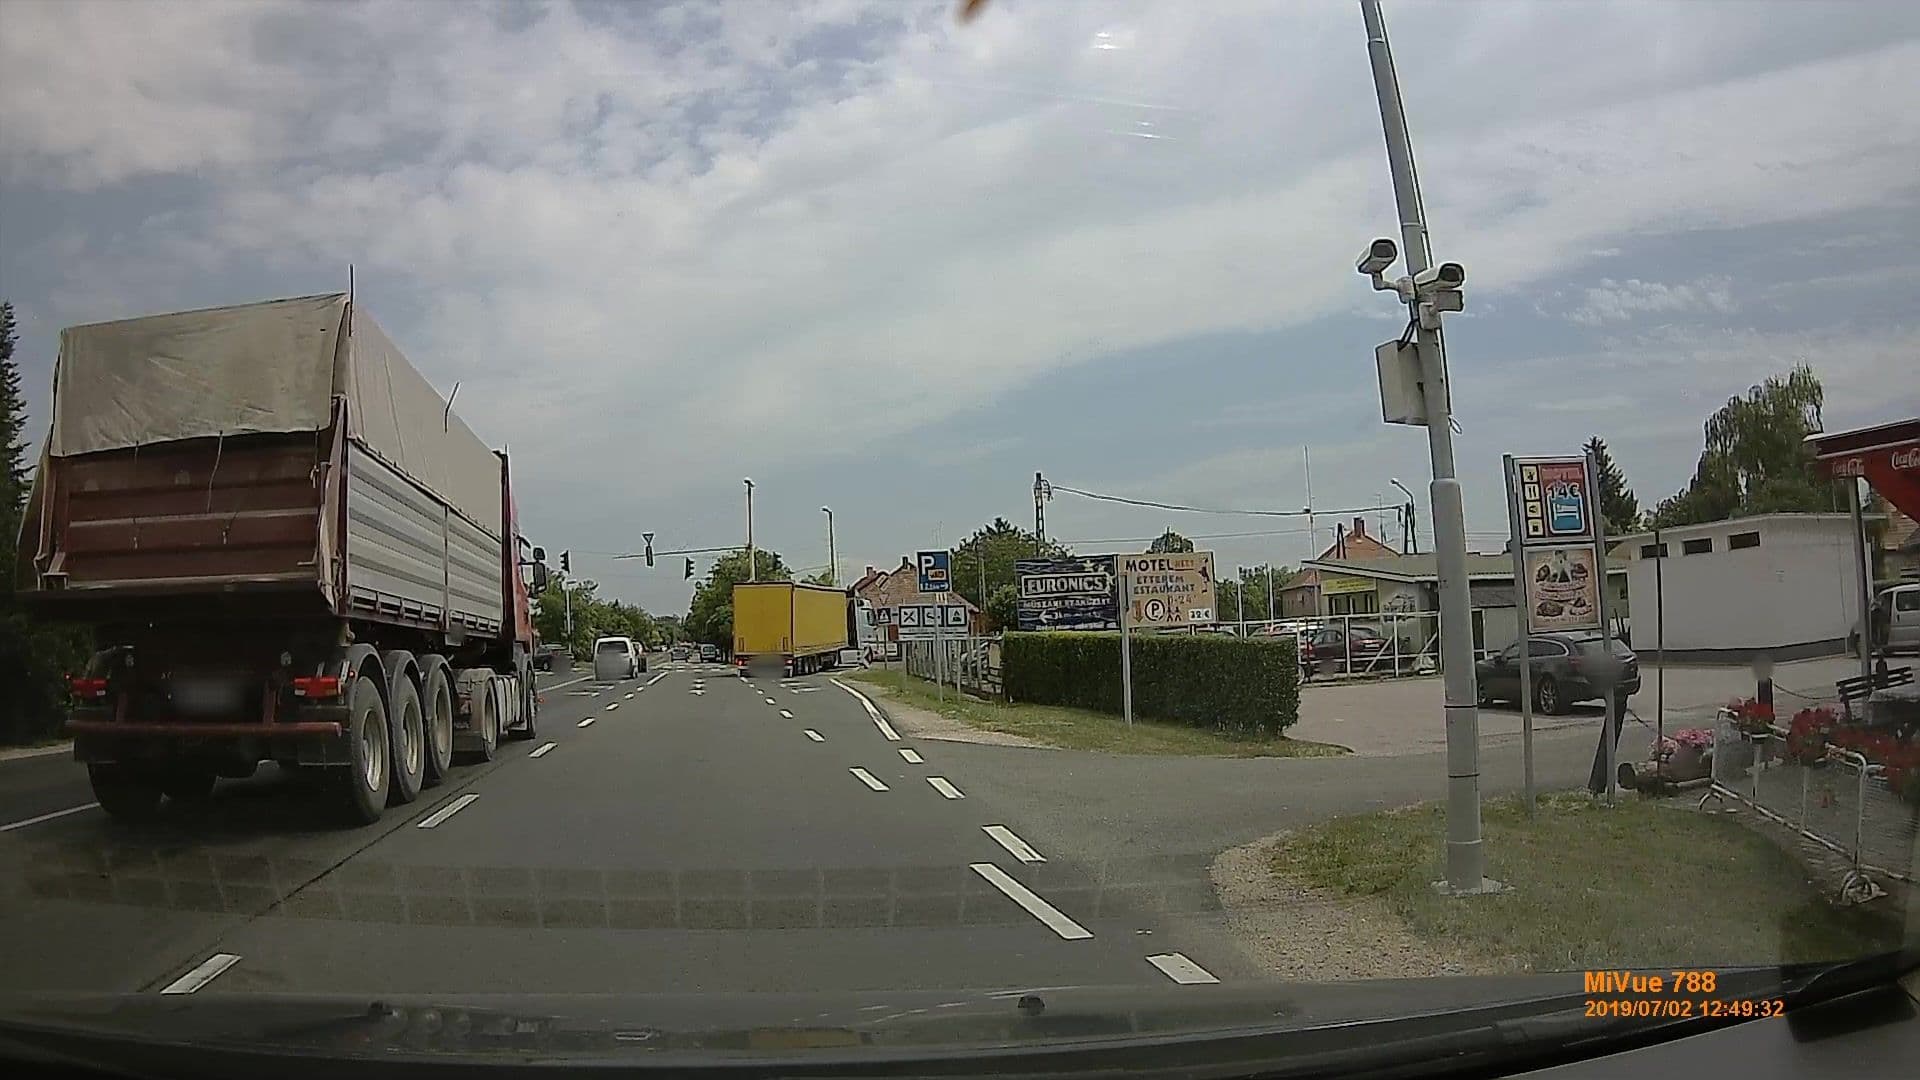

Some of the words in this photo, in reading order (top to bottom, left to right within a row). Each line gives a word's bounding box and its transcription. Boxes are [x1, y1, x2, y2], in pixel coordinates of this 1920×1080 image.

[921, 555, 935, 576] P
[1126, 559, 1174, 572] MOTEL
[1027, 576, 1104, 594] EURONICS
